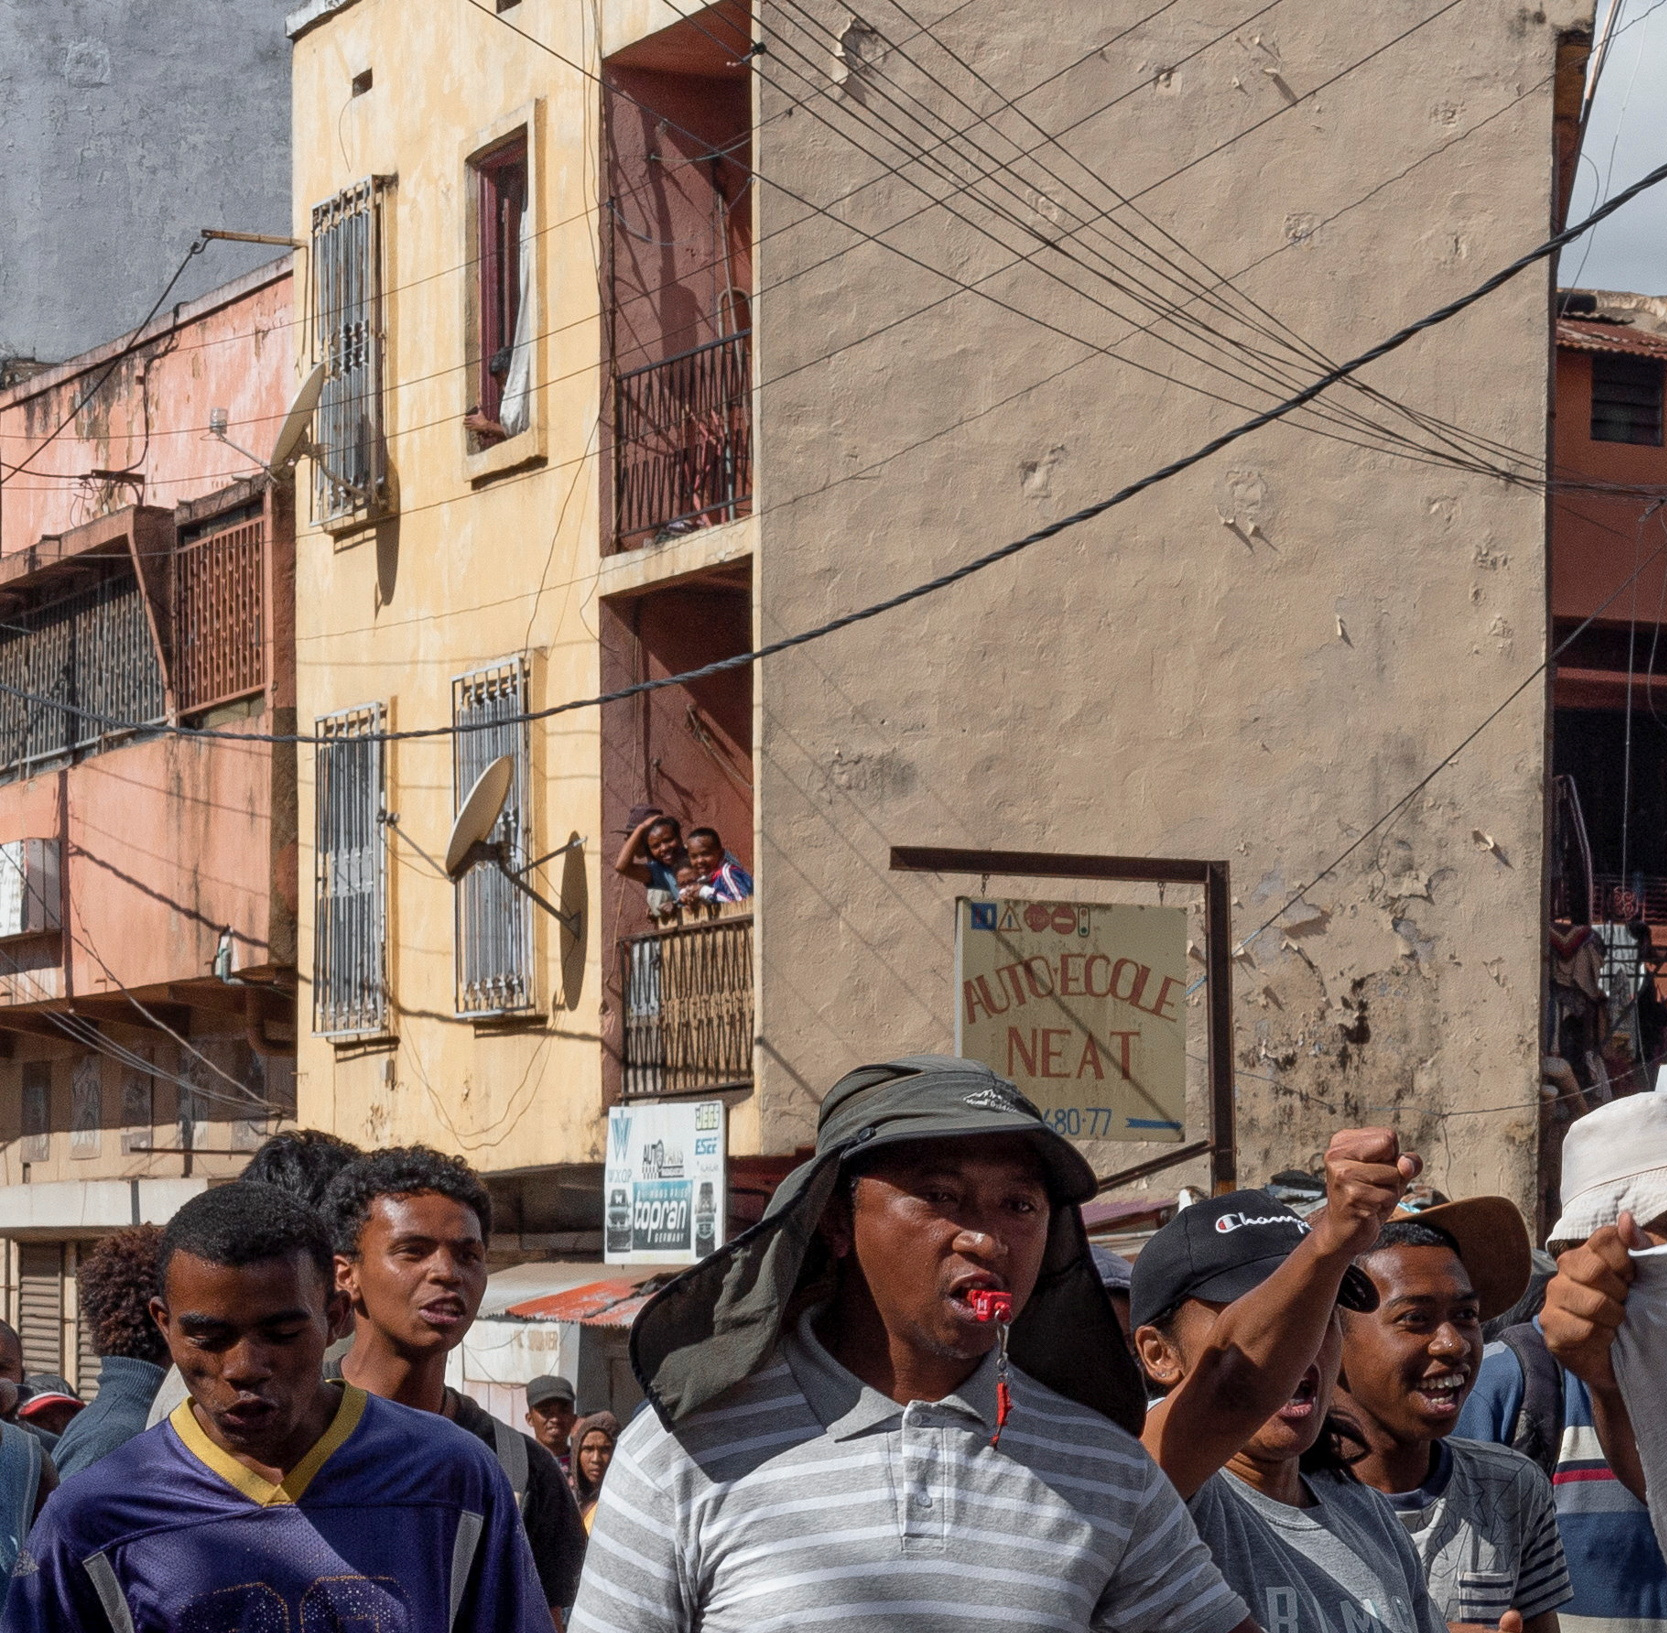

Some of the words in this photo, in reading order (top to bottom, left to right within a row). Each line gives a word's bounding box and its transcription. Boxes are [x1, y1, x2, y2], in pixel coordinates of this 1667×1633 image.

[1007, 1026, 1141, 1080] NEAT
[634, 1190, 687, 1243] topran
[654, 1232, 684, 1243] GERMANY
